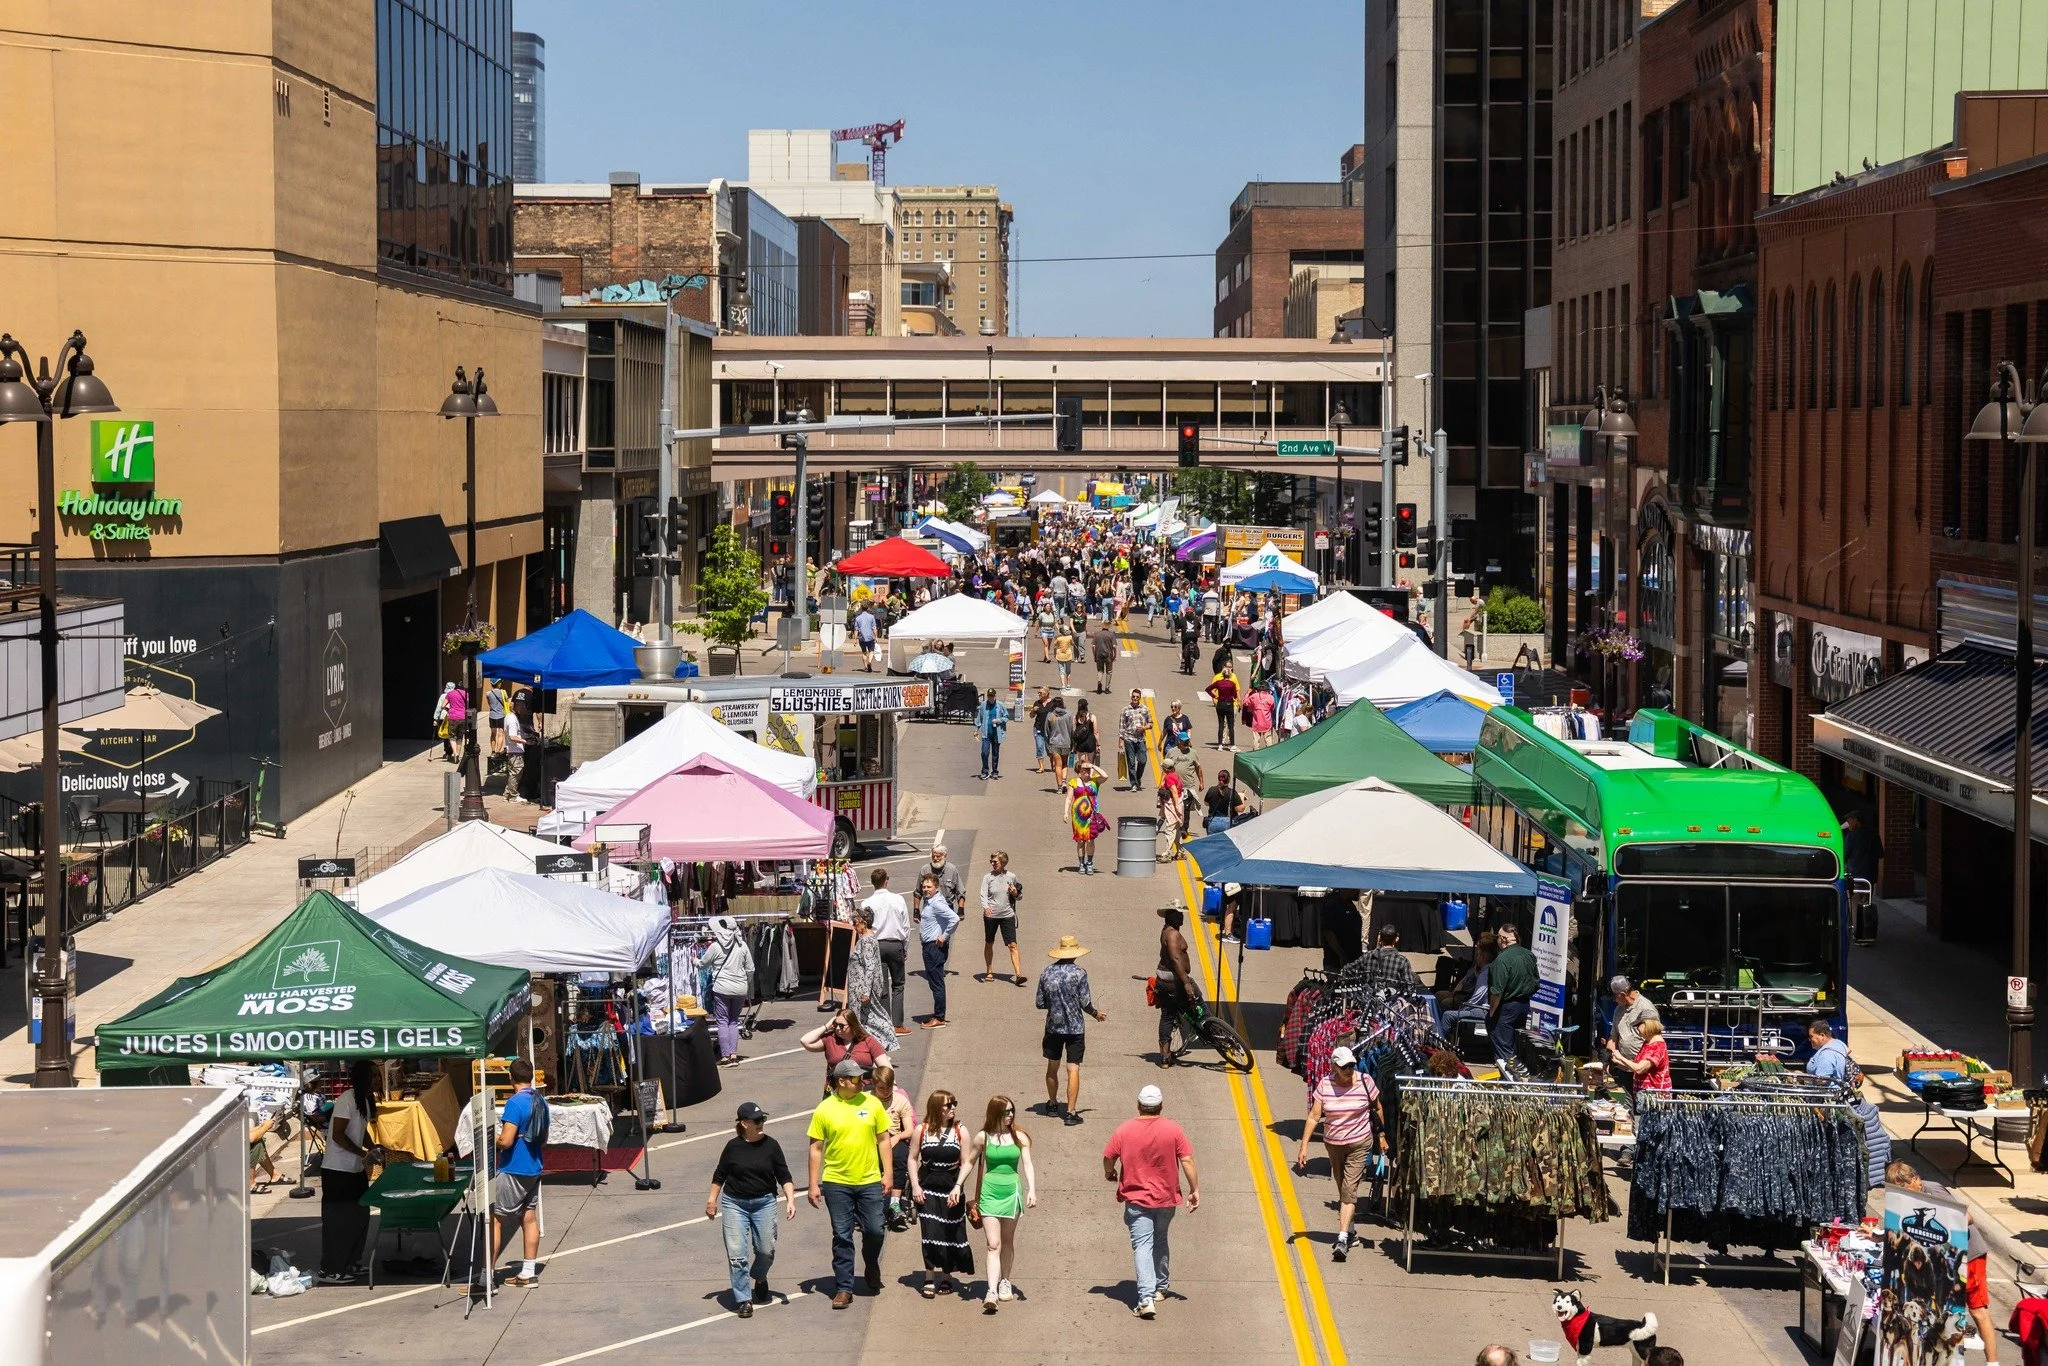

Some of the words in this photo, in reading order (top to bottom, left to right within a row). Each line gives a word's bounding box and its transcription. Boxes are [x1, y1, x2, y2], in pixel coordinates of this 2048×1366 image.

[1281, 444, 1298, 453] 2nd
[1303, 444, 1319, 453] Ave
[60, 489, 147, 521] Holiday
[1266, 532, 1303, 540] BURGERS
[142, 640, 165, 658] you
[170, 636, 197, 653] love
[1829, 650, 1850, 685] Giant
[327, 662, 344, 696] LYRIC
[721, 703, 759, 711] STRAWBERRY
[855, 687, 881, 710] KETTLE
[882, 686, 902, 708] KORN
[727, 710, 758, 718] LEMONADE
[100, 736, 133, 746] KITCHEN
[143, 735, 157, 743] BAR
[62, 772, 129, 792] Deliciously
[133, 771, 165, 787] close
[1538, 932, 1556, 945] DTA
[244, 992, 278, 1001] WILD
[281, 985, 356, 998] HARVESTED
[237, 994, 355, 1016] MOSS
[120, 1034, 207, 1056] JUICES
[229, 1029, 375, 1052] SMOOTHIES
[397, 1027, 463, 1048] GELS
